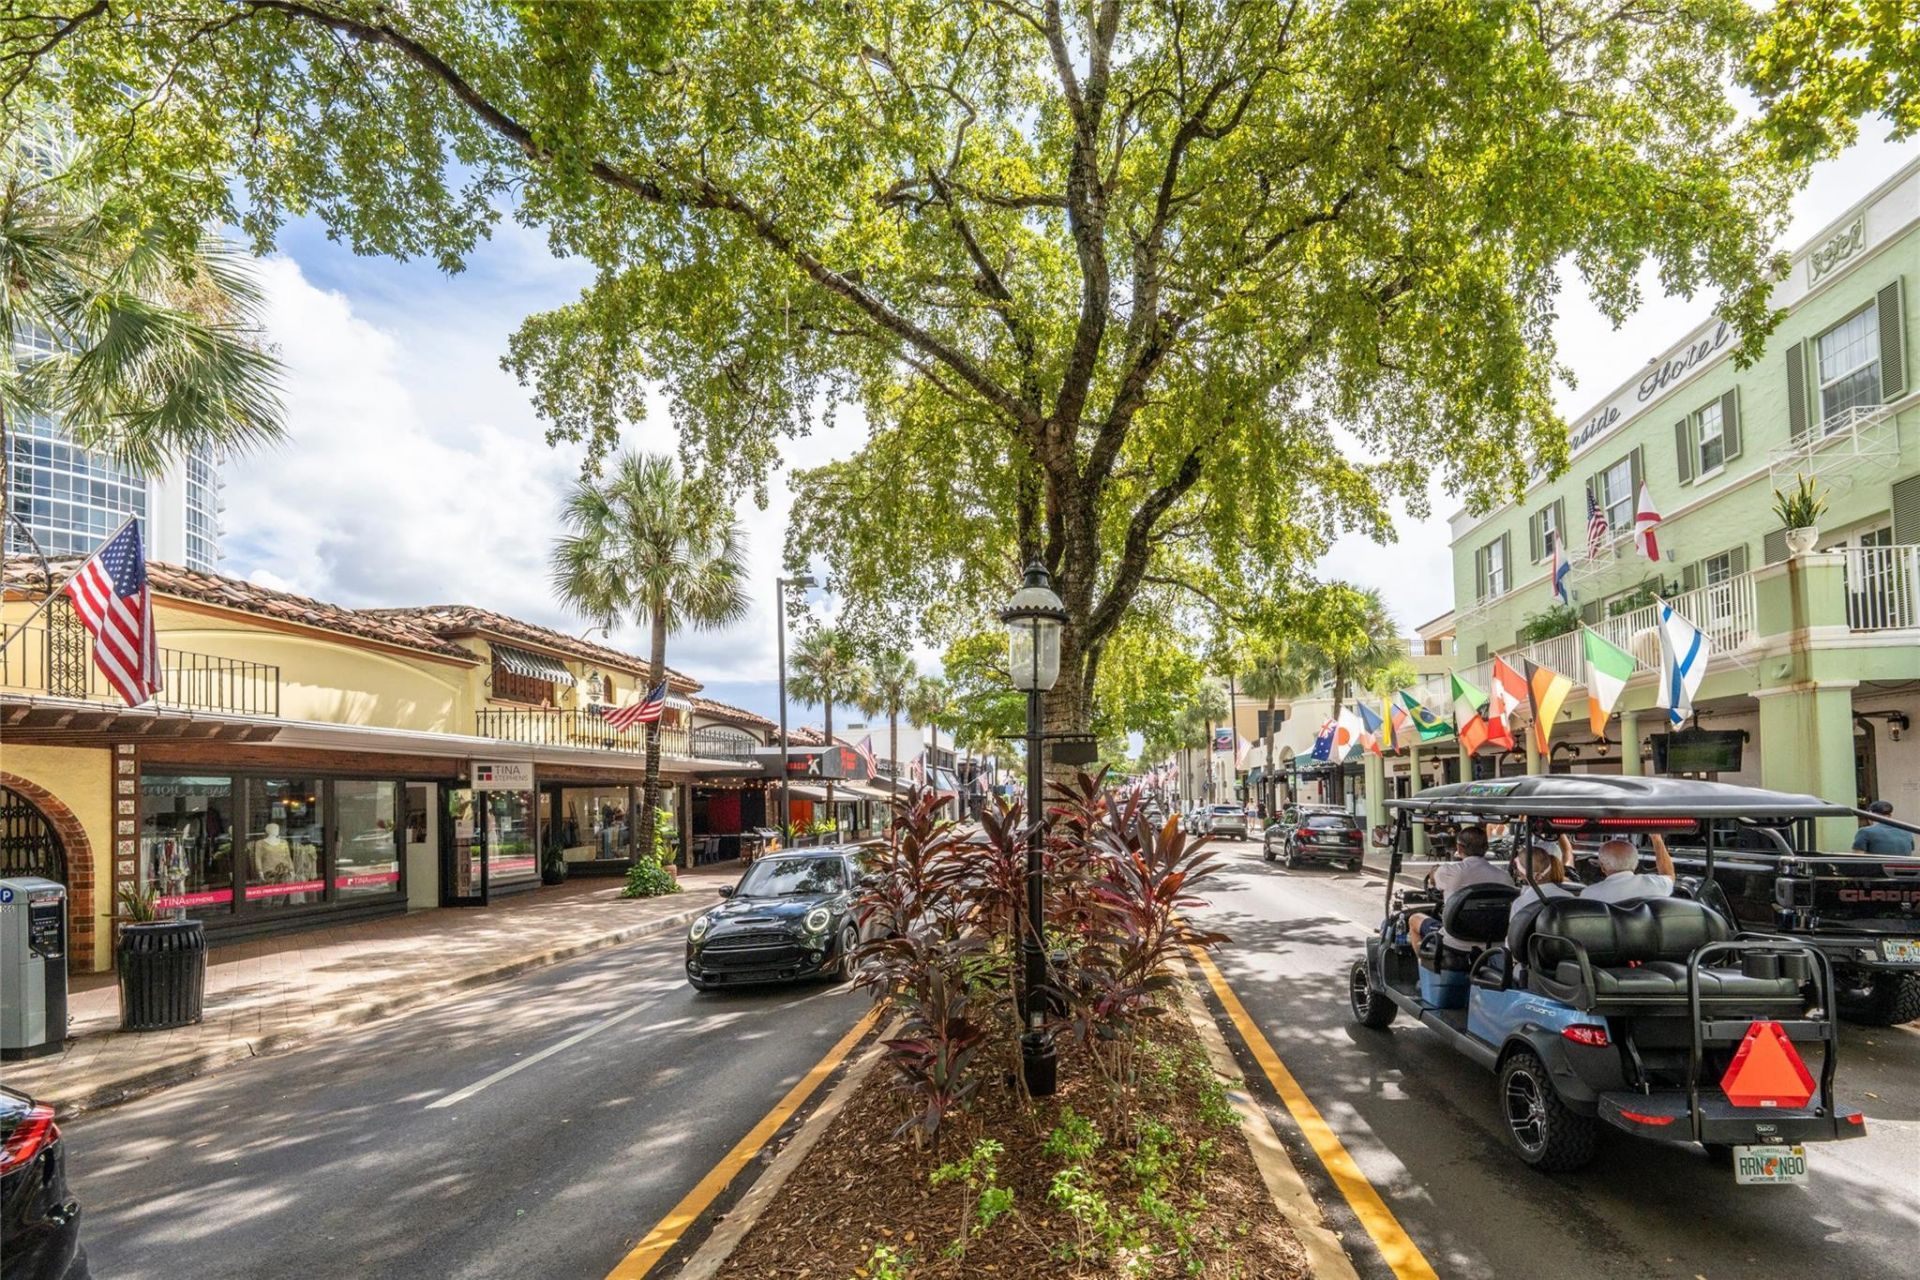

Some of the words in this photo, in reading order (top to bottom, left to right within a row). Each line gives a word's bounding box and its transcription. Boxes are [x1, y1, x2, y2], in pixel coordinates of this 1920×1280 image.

[1638, 320, 1729, 402] Hotel
[495, 765, 522, 775] TINA
[3, 890, 11, 901] P
[163, 897, 186, 906] TINA
